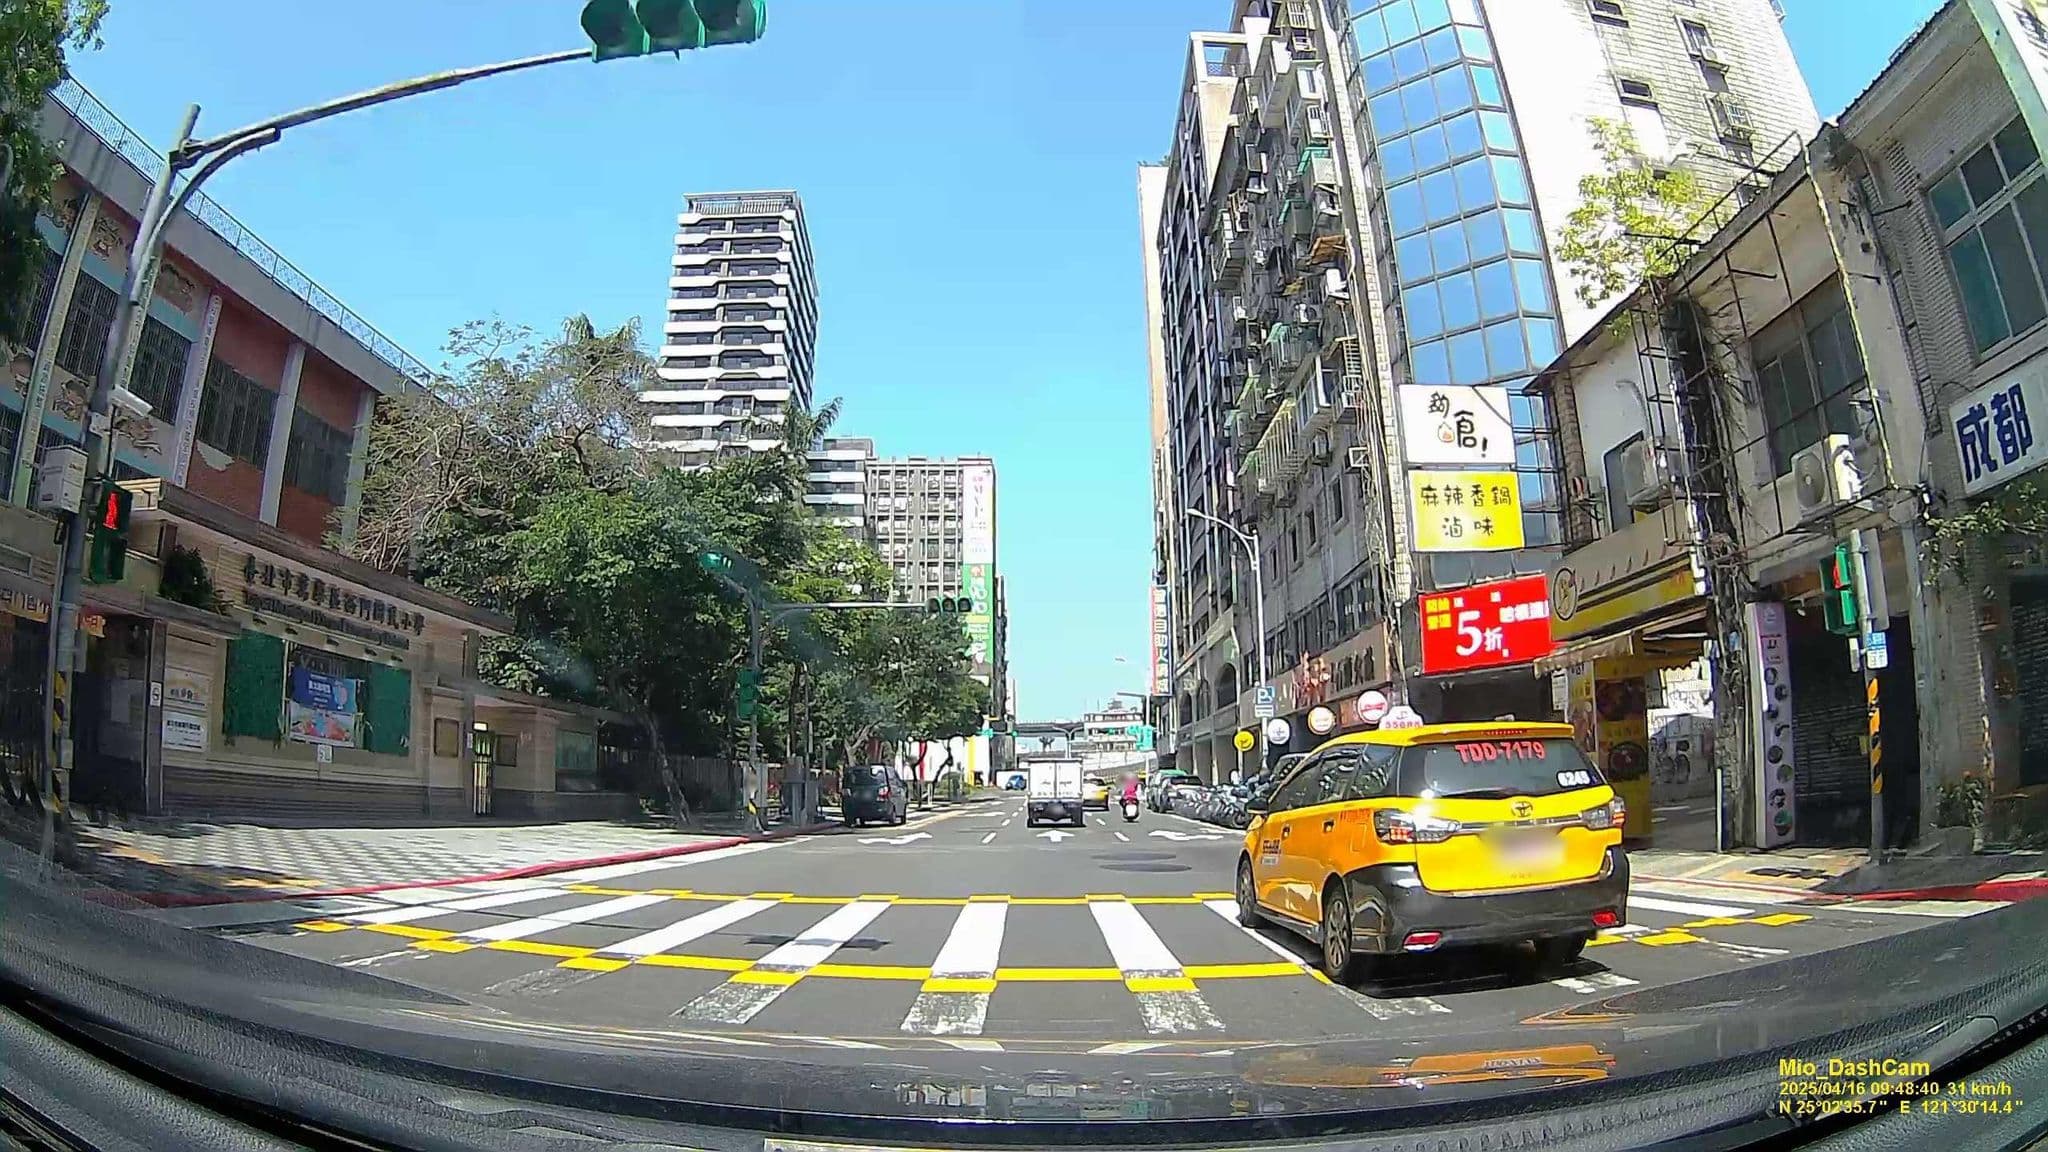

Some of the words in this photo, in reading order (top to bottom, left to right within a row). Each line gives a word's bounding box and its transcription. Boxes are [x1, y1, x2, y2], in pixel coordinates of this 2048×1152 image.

[1956, 383, 2033, 483] 成都
[1421, 484, 1512, 506] 麻辣香鍋
[1442, 516, 1494, 538] 滷味
[1455, 741, 1546, 763] TDD-7179
